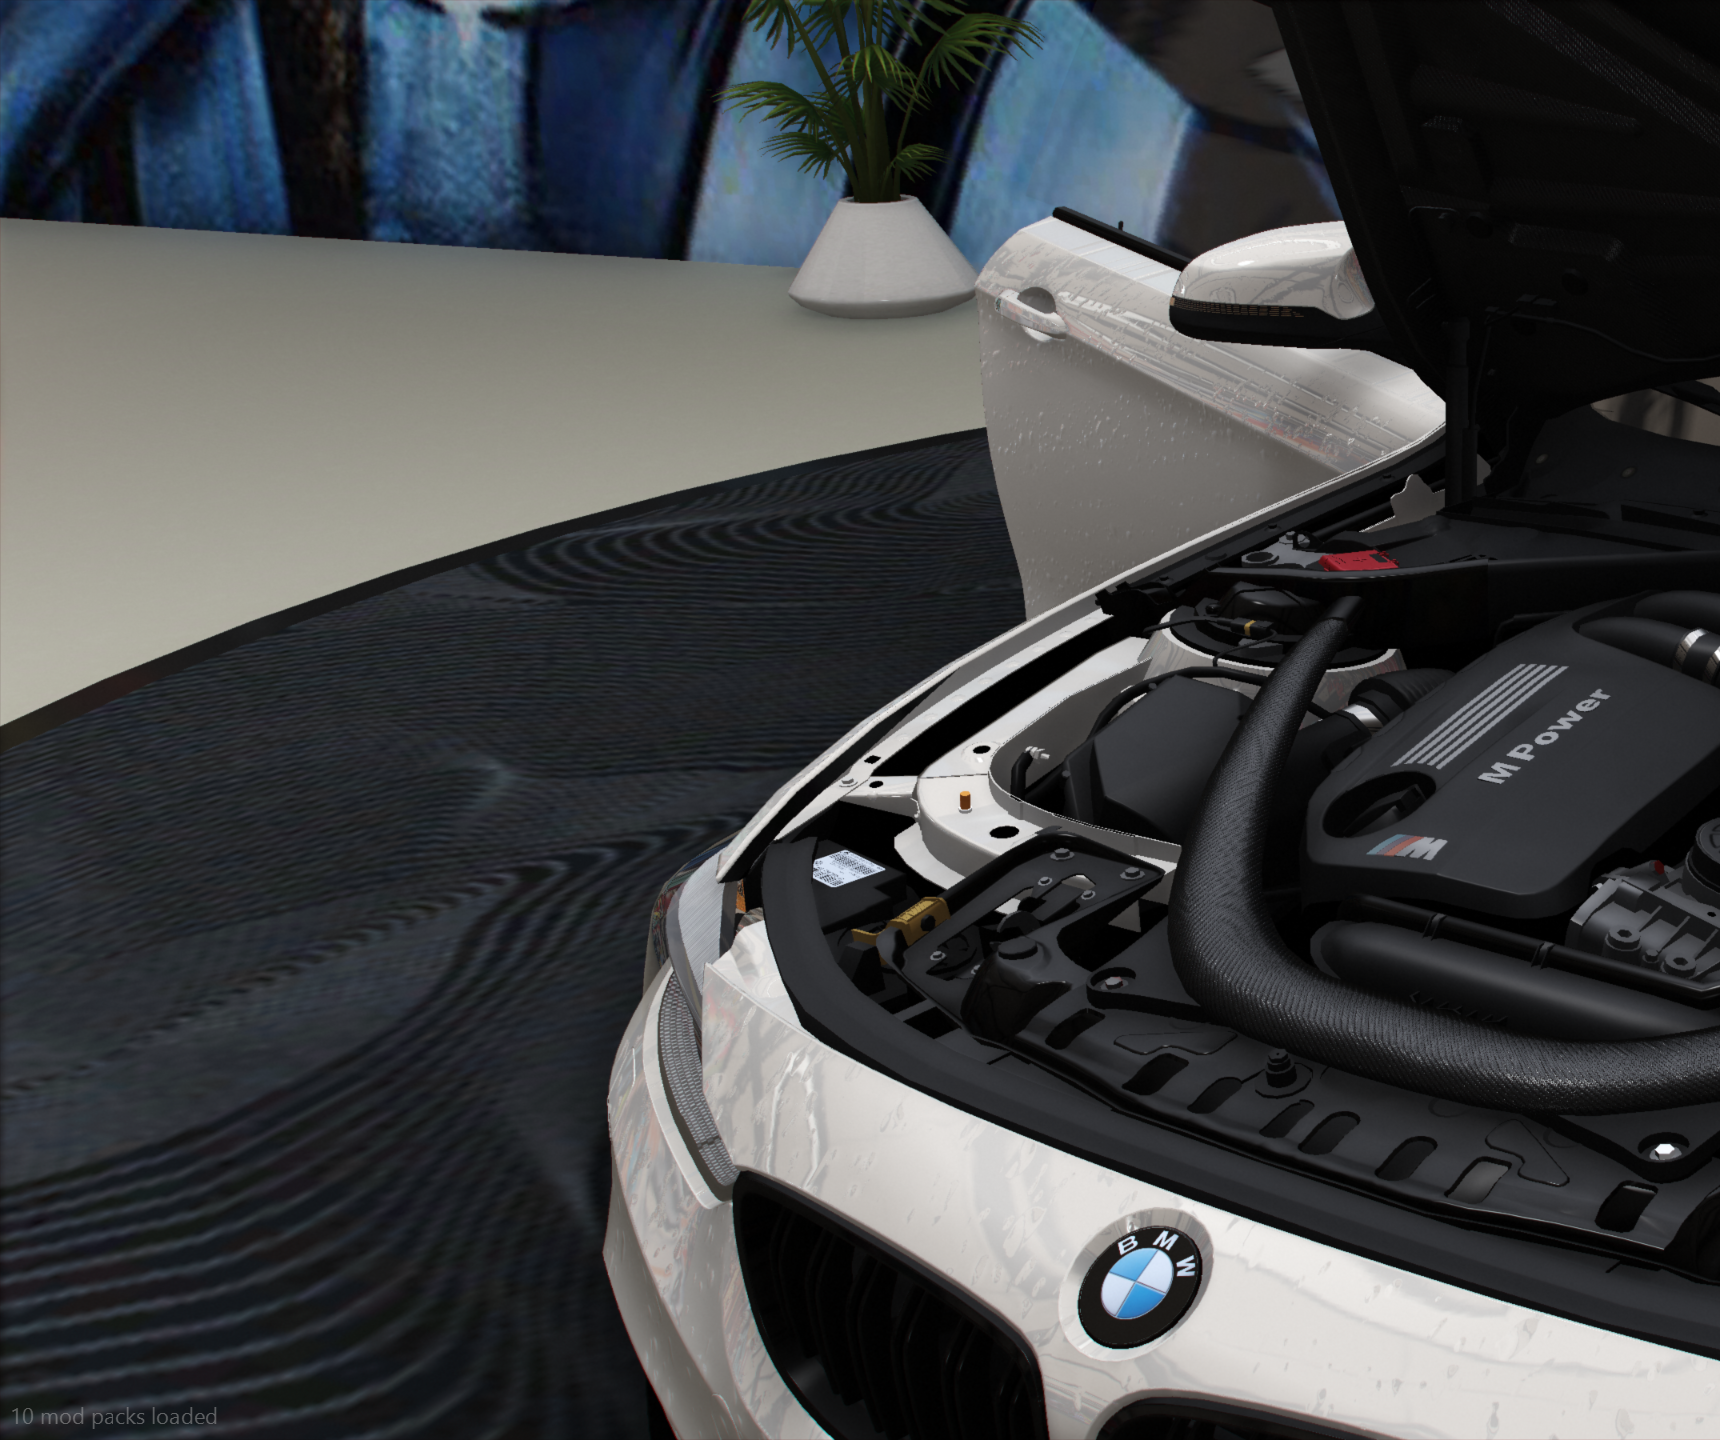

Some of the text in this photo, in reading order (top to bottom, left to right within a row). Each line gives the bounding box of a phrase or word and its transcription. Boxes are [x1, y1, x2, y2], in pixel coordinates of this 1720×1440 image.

[1477, 688, 1611, 785] M Power
[1394, 836, 1448, 861] M
[1117, 1230, 1196, 1277] BMW
